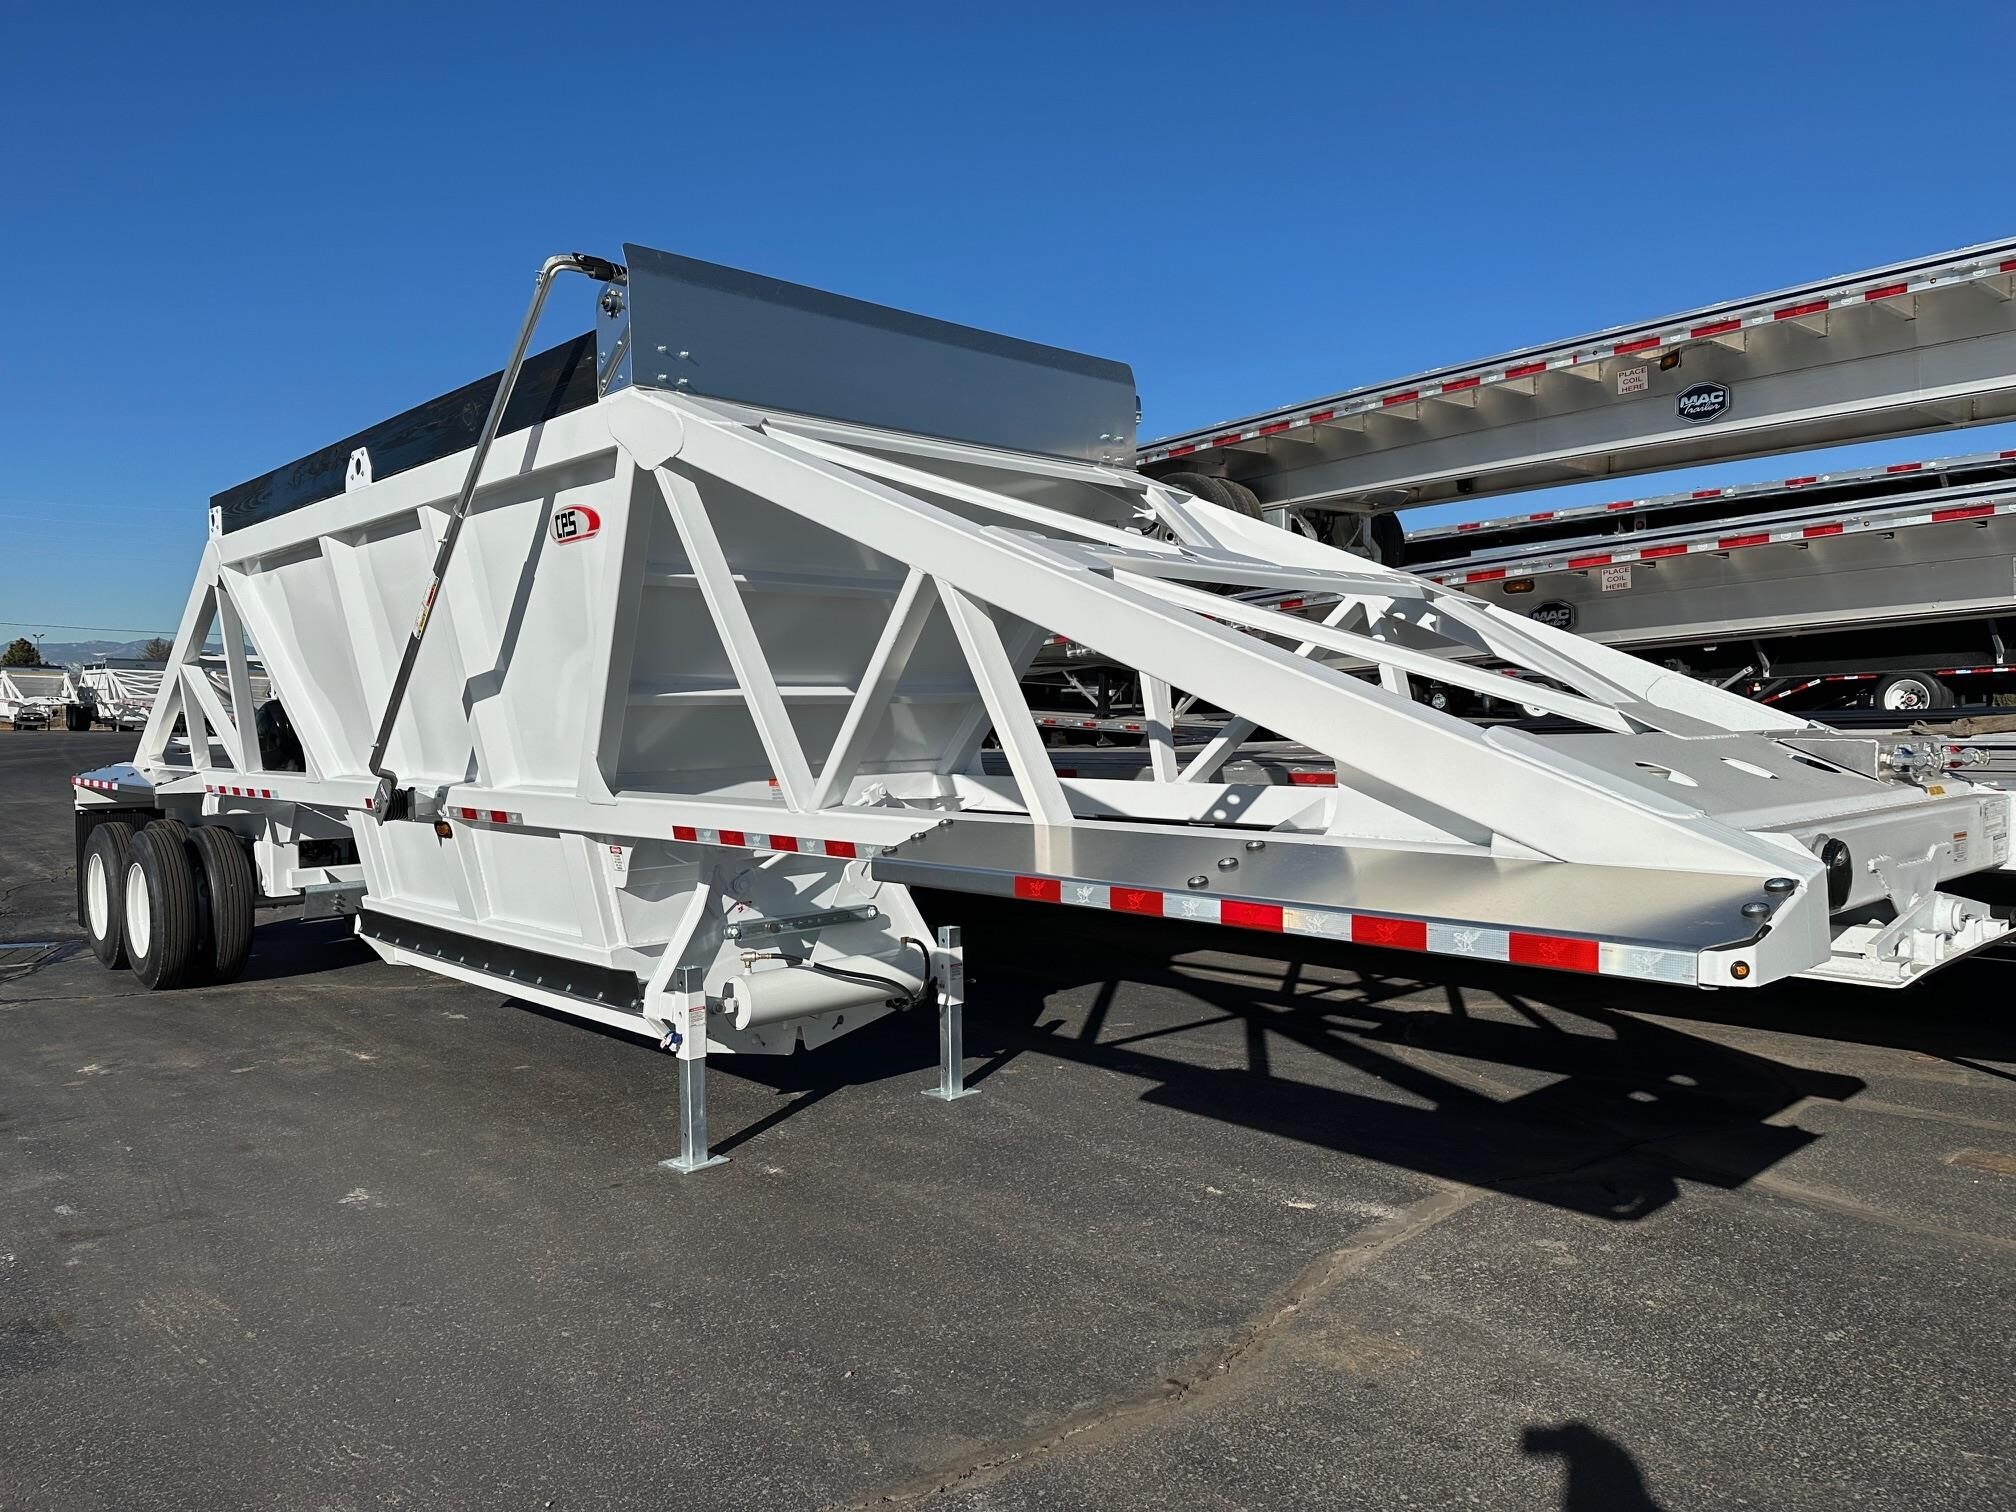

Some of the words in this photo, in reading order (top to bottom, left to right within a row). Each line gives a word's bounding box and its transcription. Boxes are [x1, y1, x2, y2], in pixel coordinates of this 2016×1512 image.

[1618, 367, 1647, 378] PLACE
[1622, 375, 1643, 385] COIL
[1621, 383, 1645, 393] HERE
[1680, 390, 1724, 408] MAC
[1683, 401, 1721, 414] Trailer
[555, 510, 577, 538] CPS
[1603, 567, 1631, 576] PLACE
[1607, 575, 1627, 583] COIL
[1605, 582, 1628, 590] HERE
[1532, 609, 1570, 621] MAC
